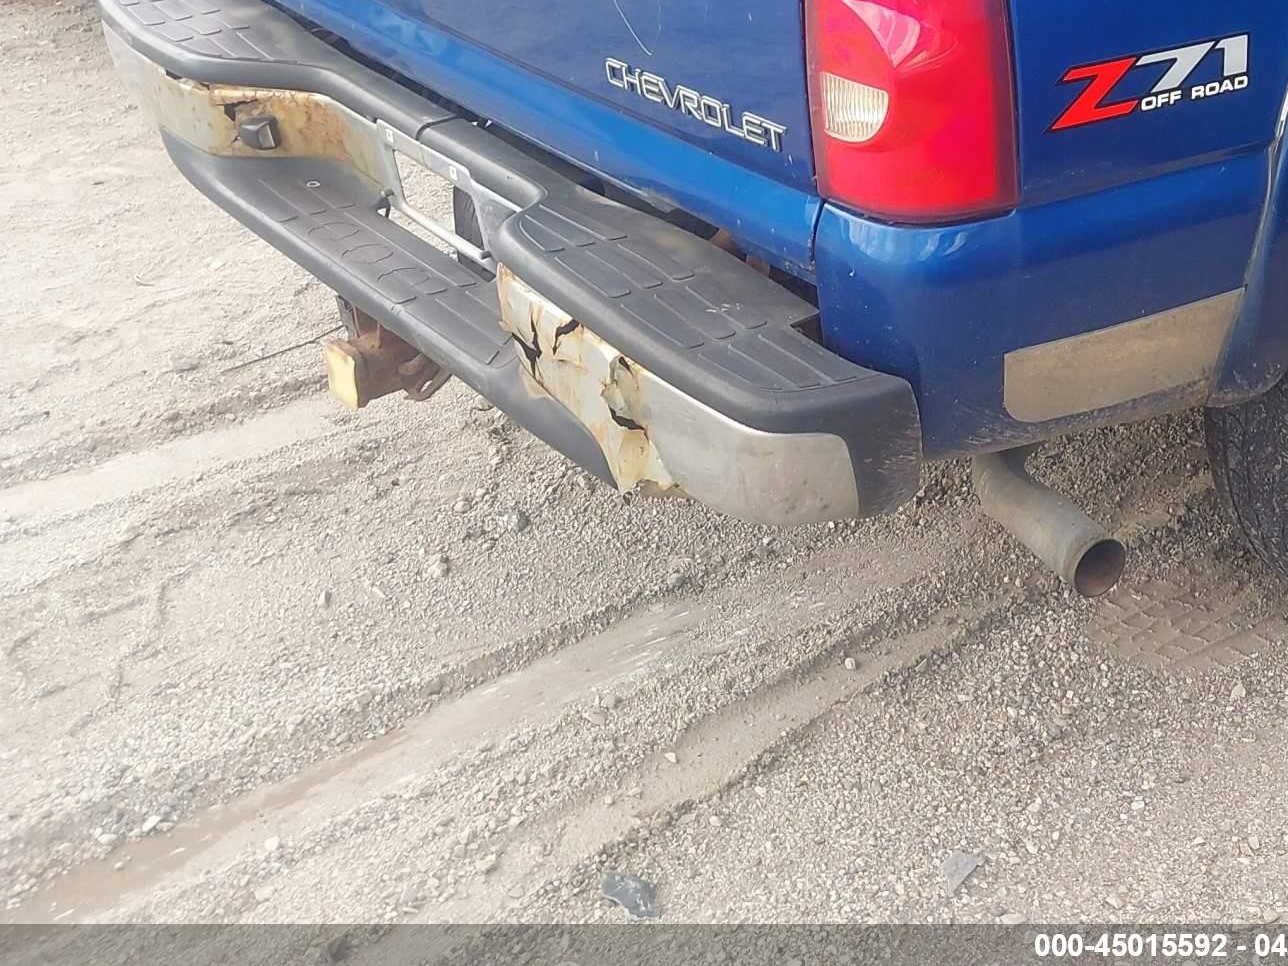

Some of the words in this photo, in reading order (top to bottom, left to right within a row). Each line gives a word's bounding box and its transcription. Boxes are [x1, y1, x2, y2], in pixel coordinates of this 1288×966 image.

[605, 57, 788, 152] CHEVROLET
[1050, 34, 1249, 130] Z71
[1141, 91, 1182, 111] OFF
[1191, 75, 1248, 100] ROAD
